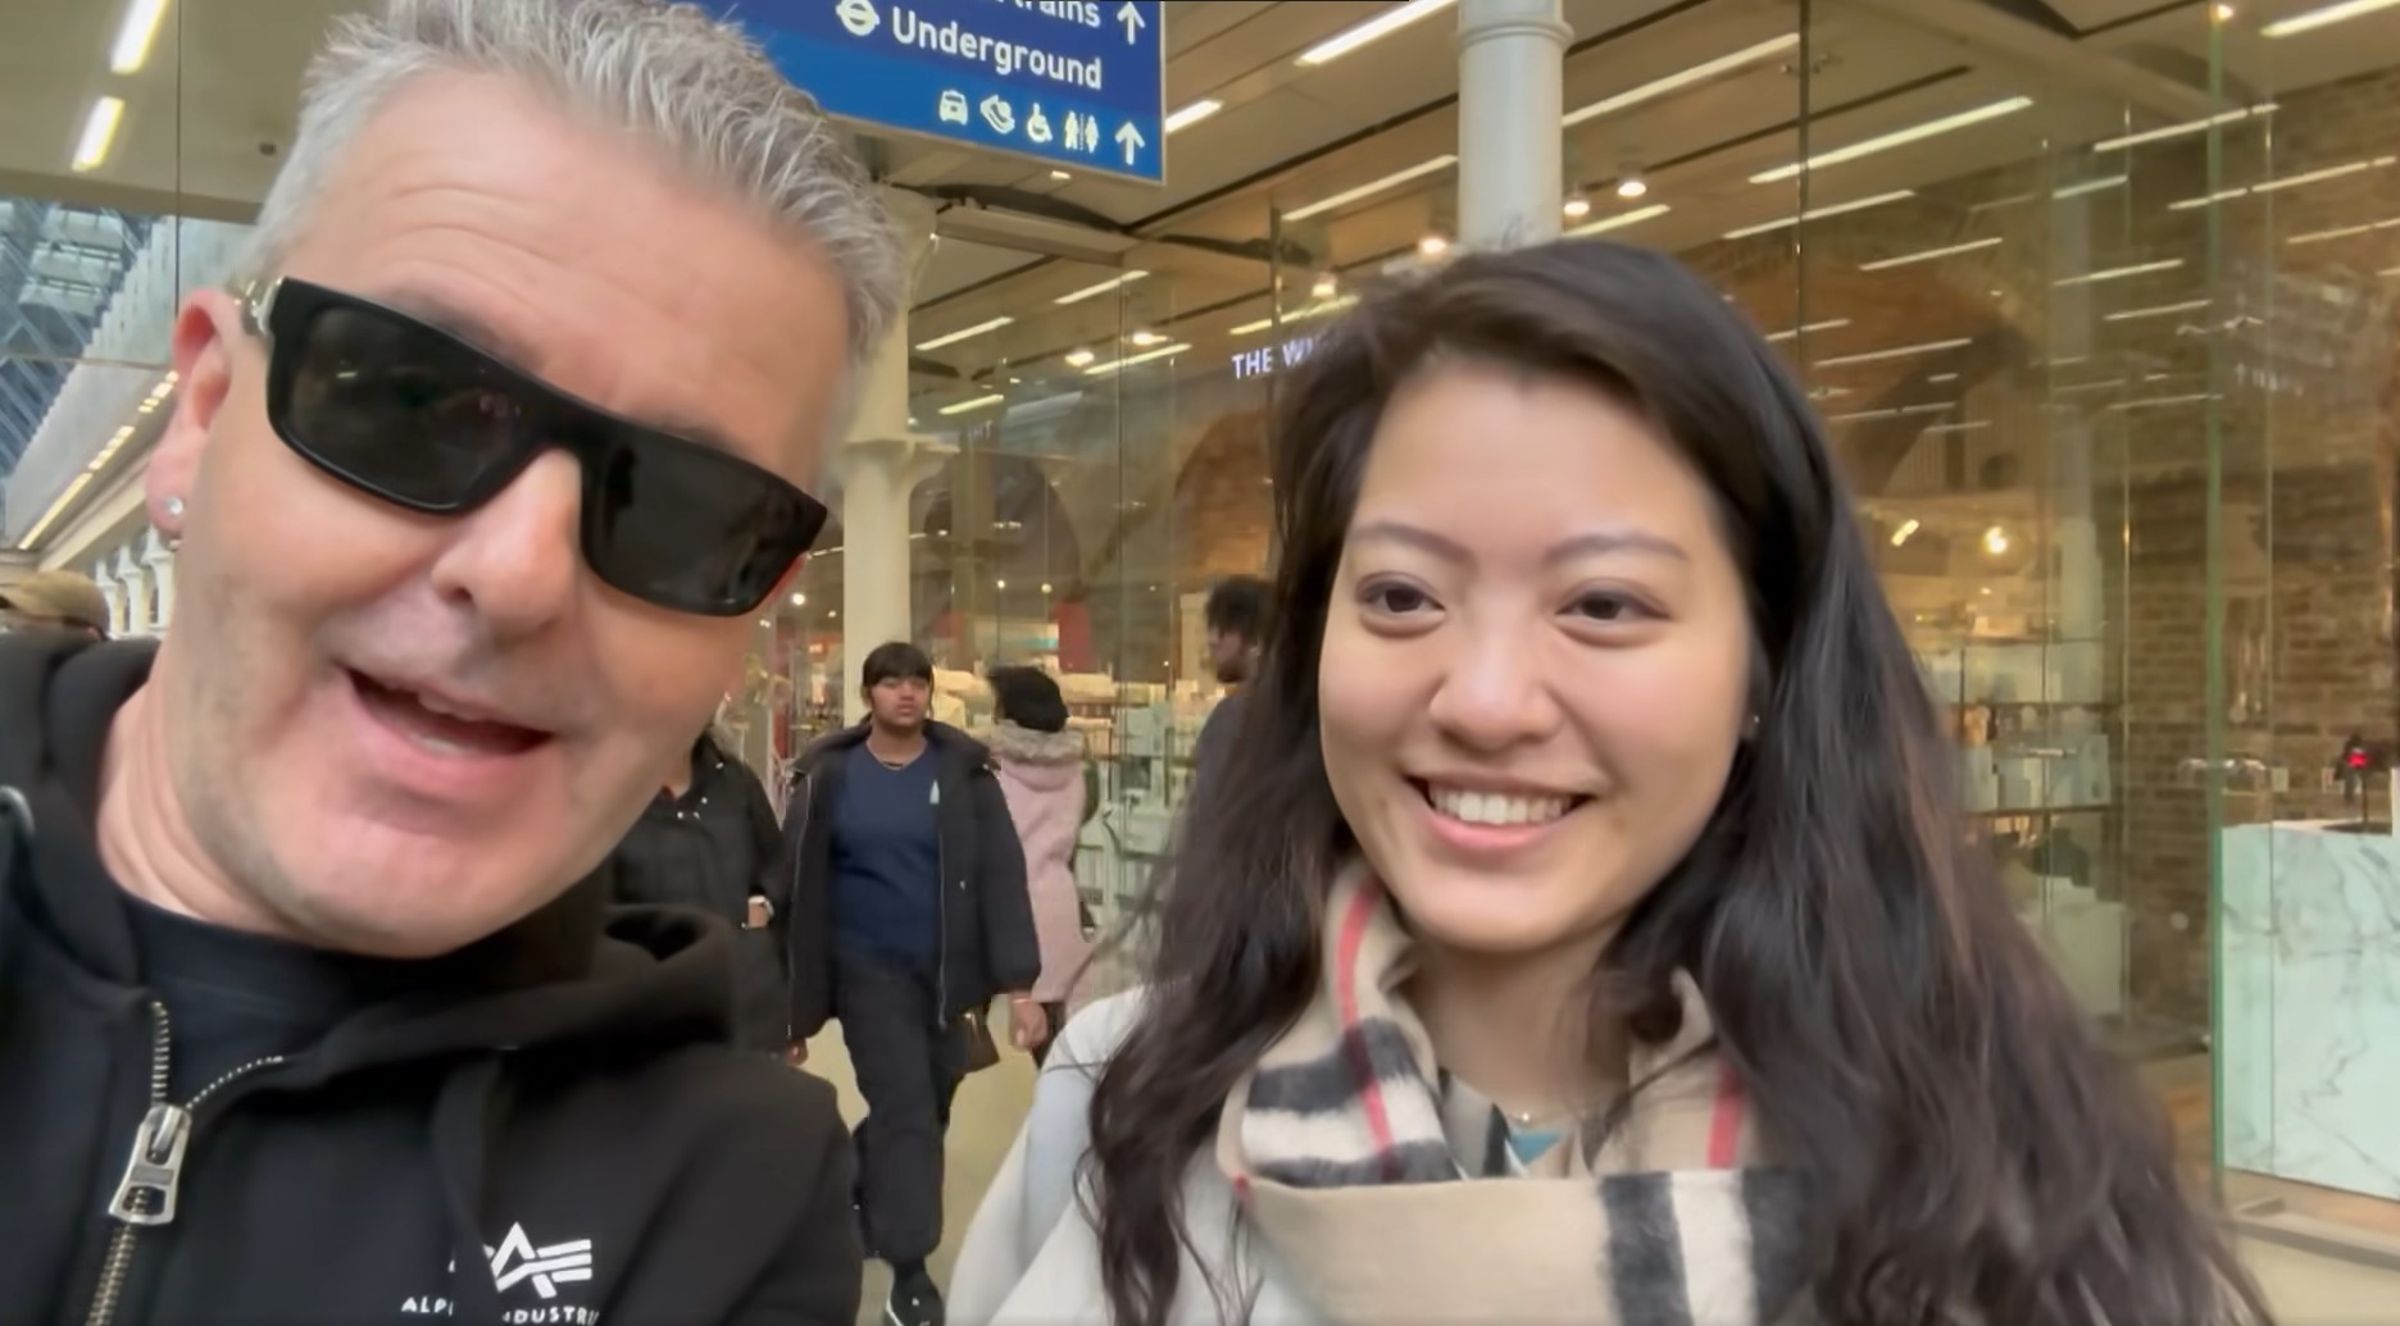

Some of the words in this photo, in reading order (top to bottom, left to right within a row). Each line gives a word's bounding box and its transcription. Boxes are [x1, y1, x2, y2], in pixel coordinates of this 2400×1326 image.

[1014, 0, 1101, 28] ains
[893, 6, 1102, 90] Underground
[1231, 348, 1273, 380] THE
[401, 1296, 454, 1317] ALP
